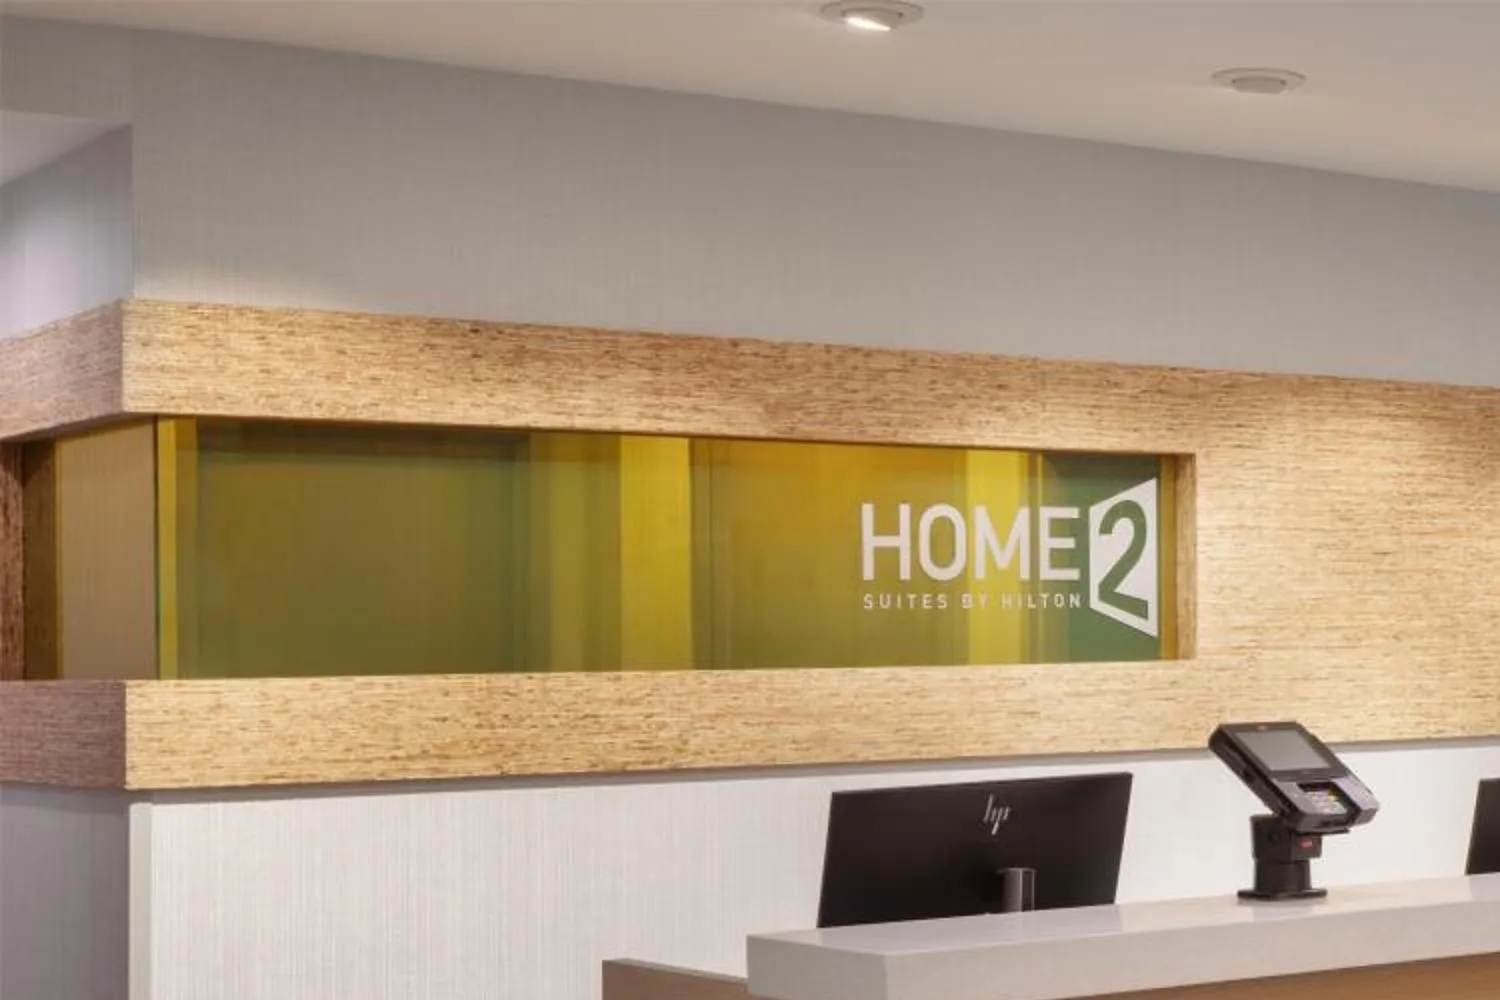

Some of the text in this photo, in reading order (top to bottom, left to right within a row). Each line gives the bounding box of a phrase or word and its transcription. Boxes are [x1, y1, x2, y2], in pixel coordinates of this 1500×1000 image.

[862, 591, 1082, 610] SUITES BY HILTON
[983, 793, 1011, 835] hp
